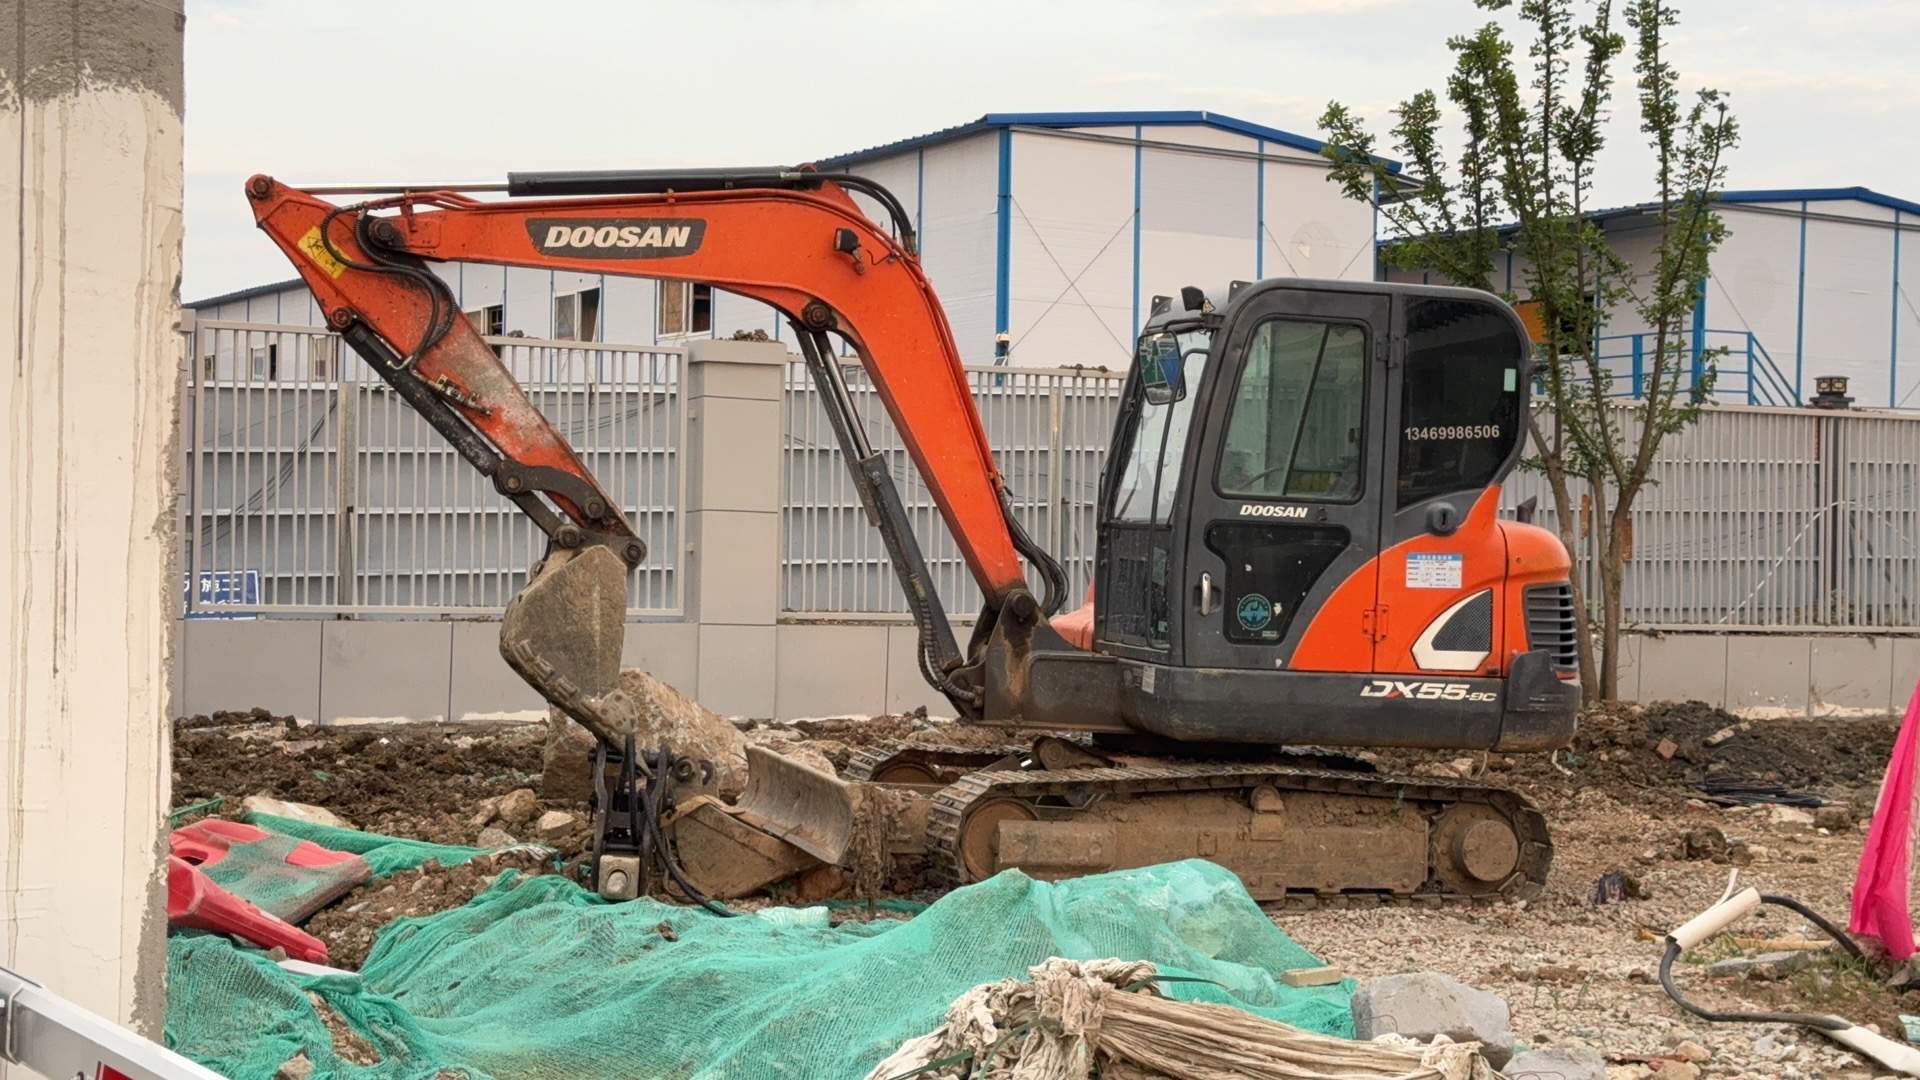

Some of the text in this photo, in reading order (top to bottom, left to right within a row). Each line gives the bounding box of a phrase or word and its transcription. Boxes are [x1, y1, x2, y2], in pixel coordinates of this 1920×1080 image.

[543, 226, 691, 247] DOOSAN
[1404, 425, 1500, 440] 13469986506
[1240, 504, 1308, 518] DOOSAN
